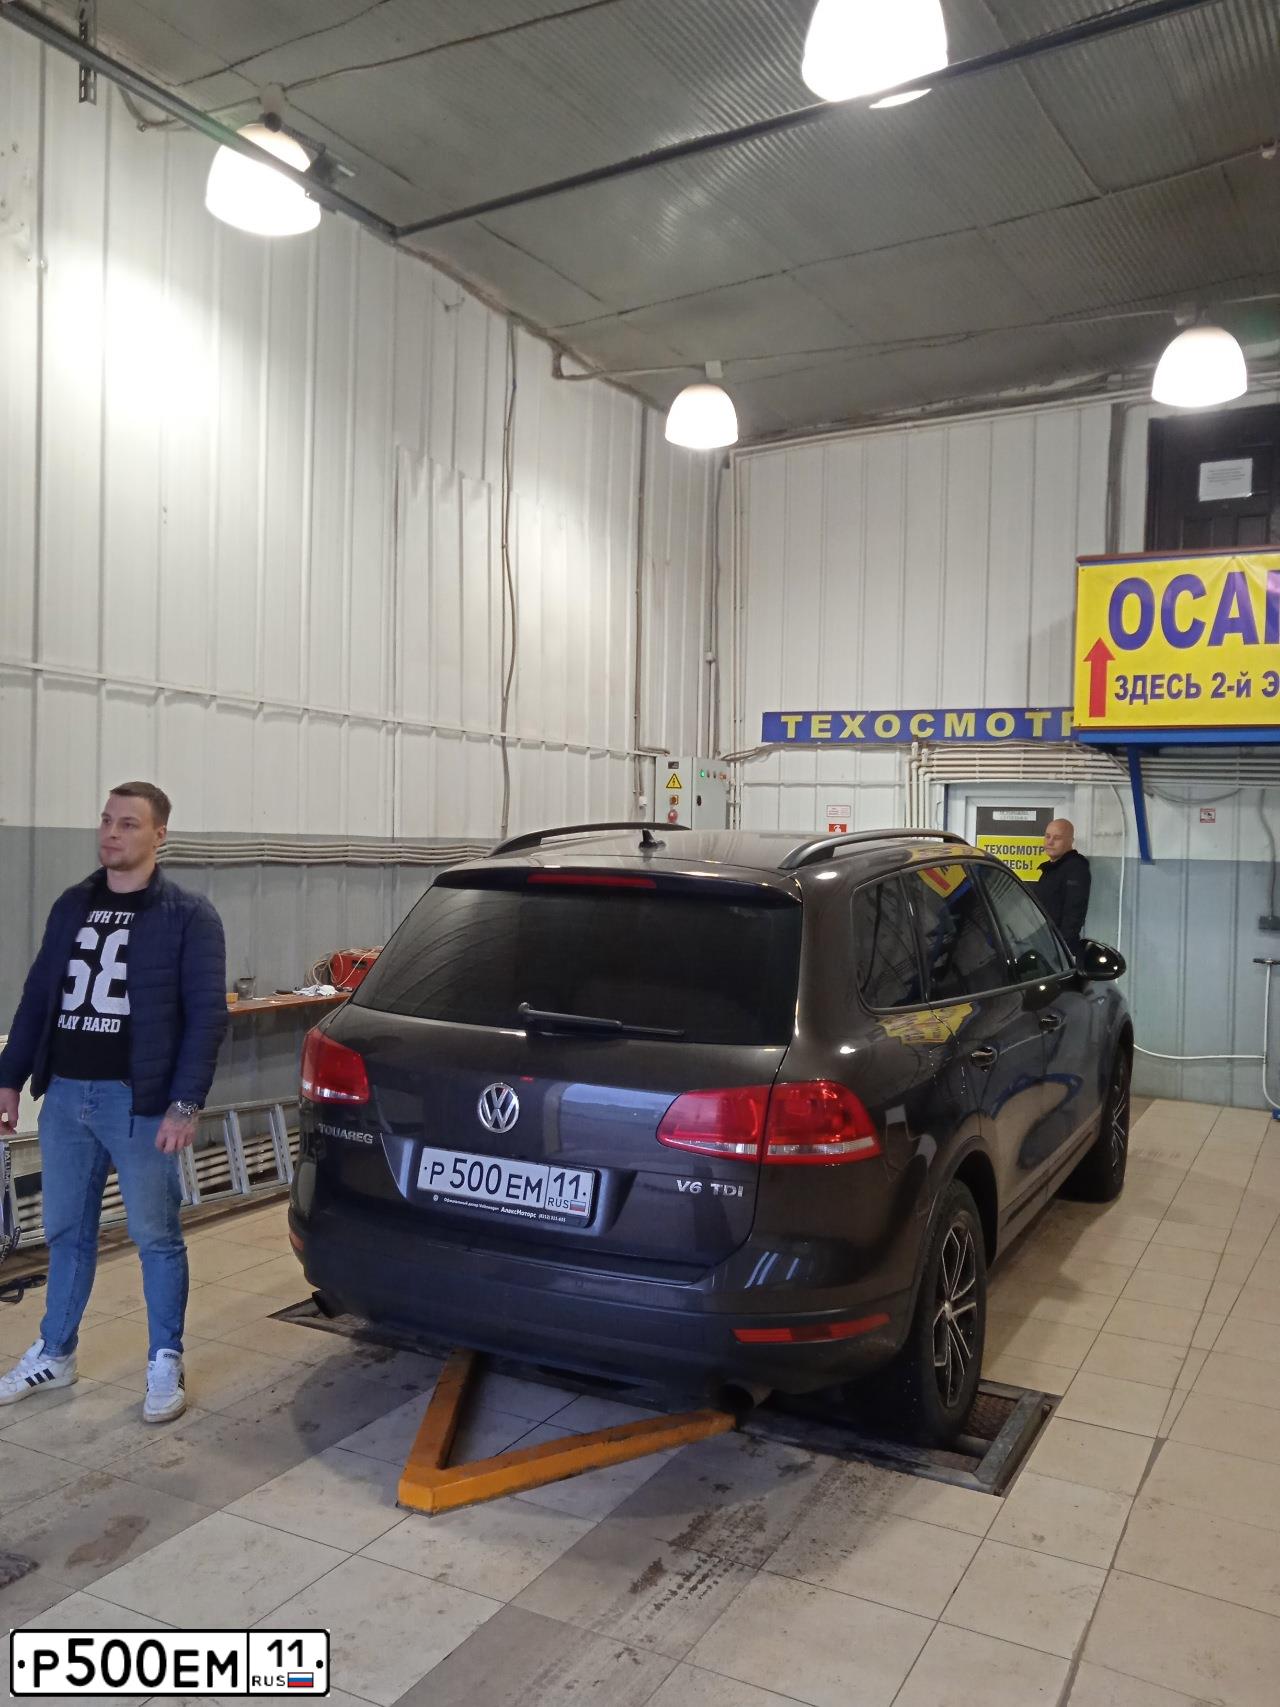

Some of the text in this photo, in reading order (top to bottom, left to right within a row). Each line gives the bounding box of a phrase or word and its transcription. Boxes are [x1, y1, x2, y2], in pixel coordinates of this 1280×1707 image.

[1114, 673, 1202, 705] ЗДЕСЬ
[1211, 671, 1252, 699] 2-й
[984, 845, 1045, 856] ТЕХОСМОТР
[57, 1014, 121, 1033] PLAY HARD
[318, 1123, 374, 1145] TOUAREG
[553, 1172, 582, 1200] 11
[676, 1180, 744, 1198] V6 TDI
[548, 1197, 569, 1209] RUS
